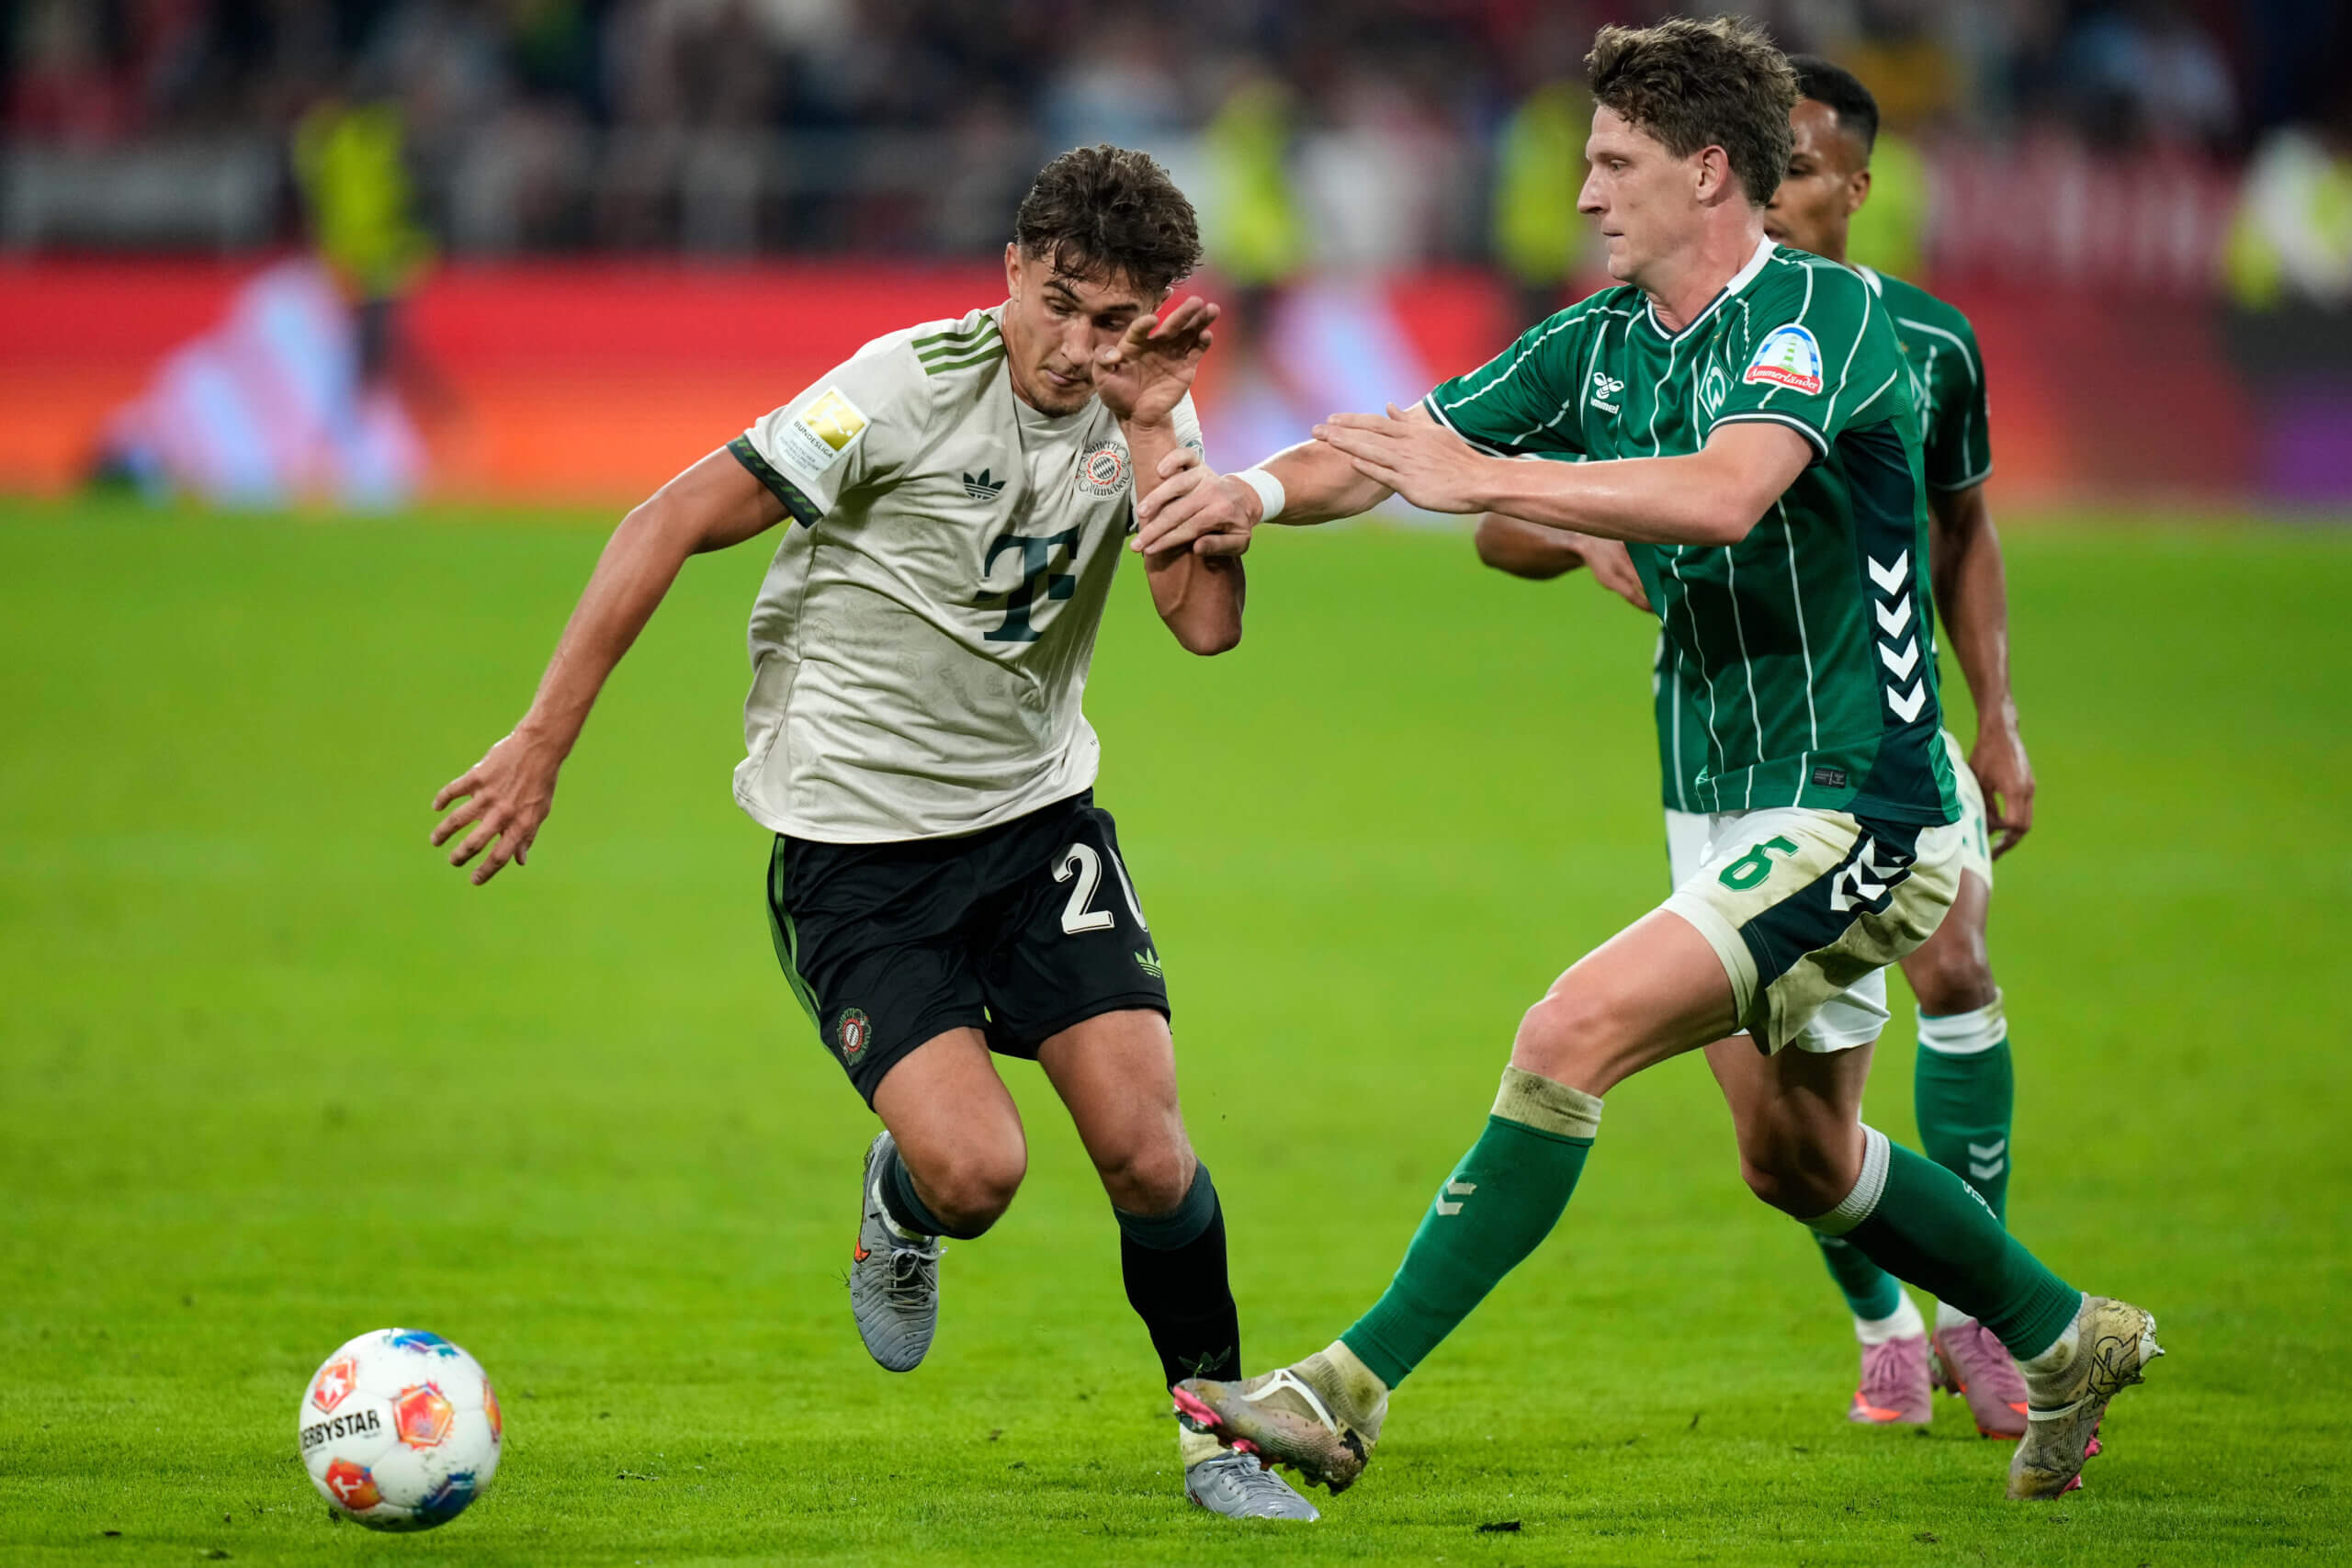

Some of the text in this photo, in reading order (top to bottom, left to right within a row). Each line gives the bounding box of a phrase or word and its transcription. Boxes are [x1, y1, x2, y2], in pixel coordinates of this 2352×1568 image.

[793, 420, 833, 459] BUNDESLIGA
[1717, 835, 1799, 892] 6
[301, 1409, 380, 1450] ERBYSTAR
